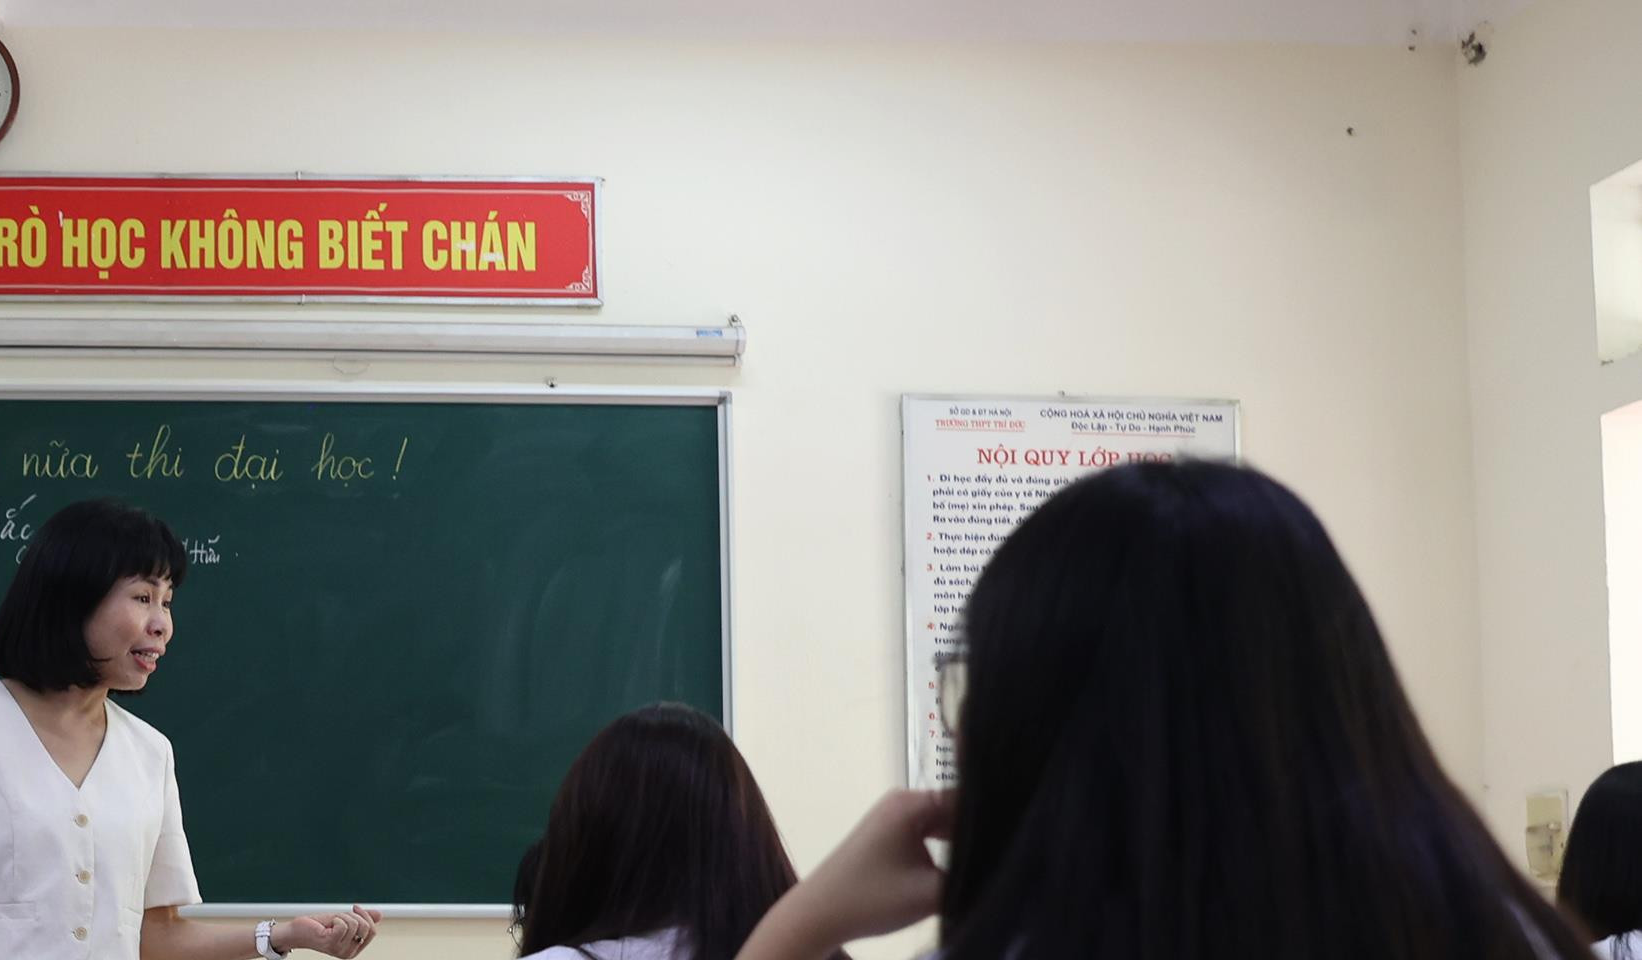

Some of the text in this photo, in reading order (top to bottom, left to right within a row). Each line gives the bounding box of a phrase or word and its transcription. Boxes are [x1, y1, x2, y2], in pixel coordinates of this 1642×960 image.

[61, 216, 146, 280] HỌC
[161, 208, 304, 271] KHÔNG
[318, 202, 409, 271] BIẾT
[422, 210, 537, 272] CHÁN
[1202, 414, 1223, 423] NAM
[22, 439, 98, 479] nữa
[126, 424, 185, 480] thi
[214, 434, 284, 490] đại
[312, 432, 375, 488] học
[977, 443, 1121, 469] NỘI QUY LỚP
